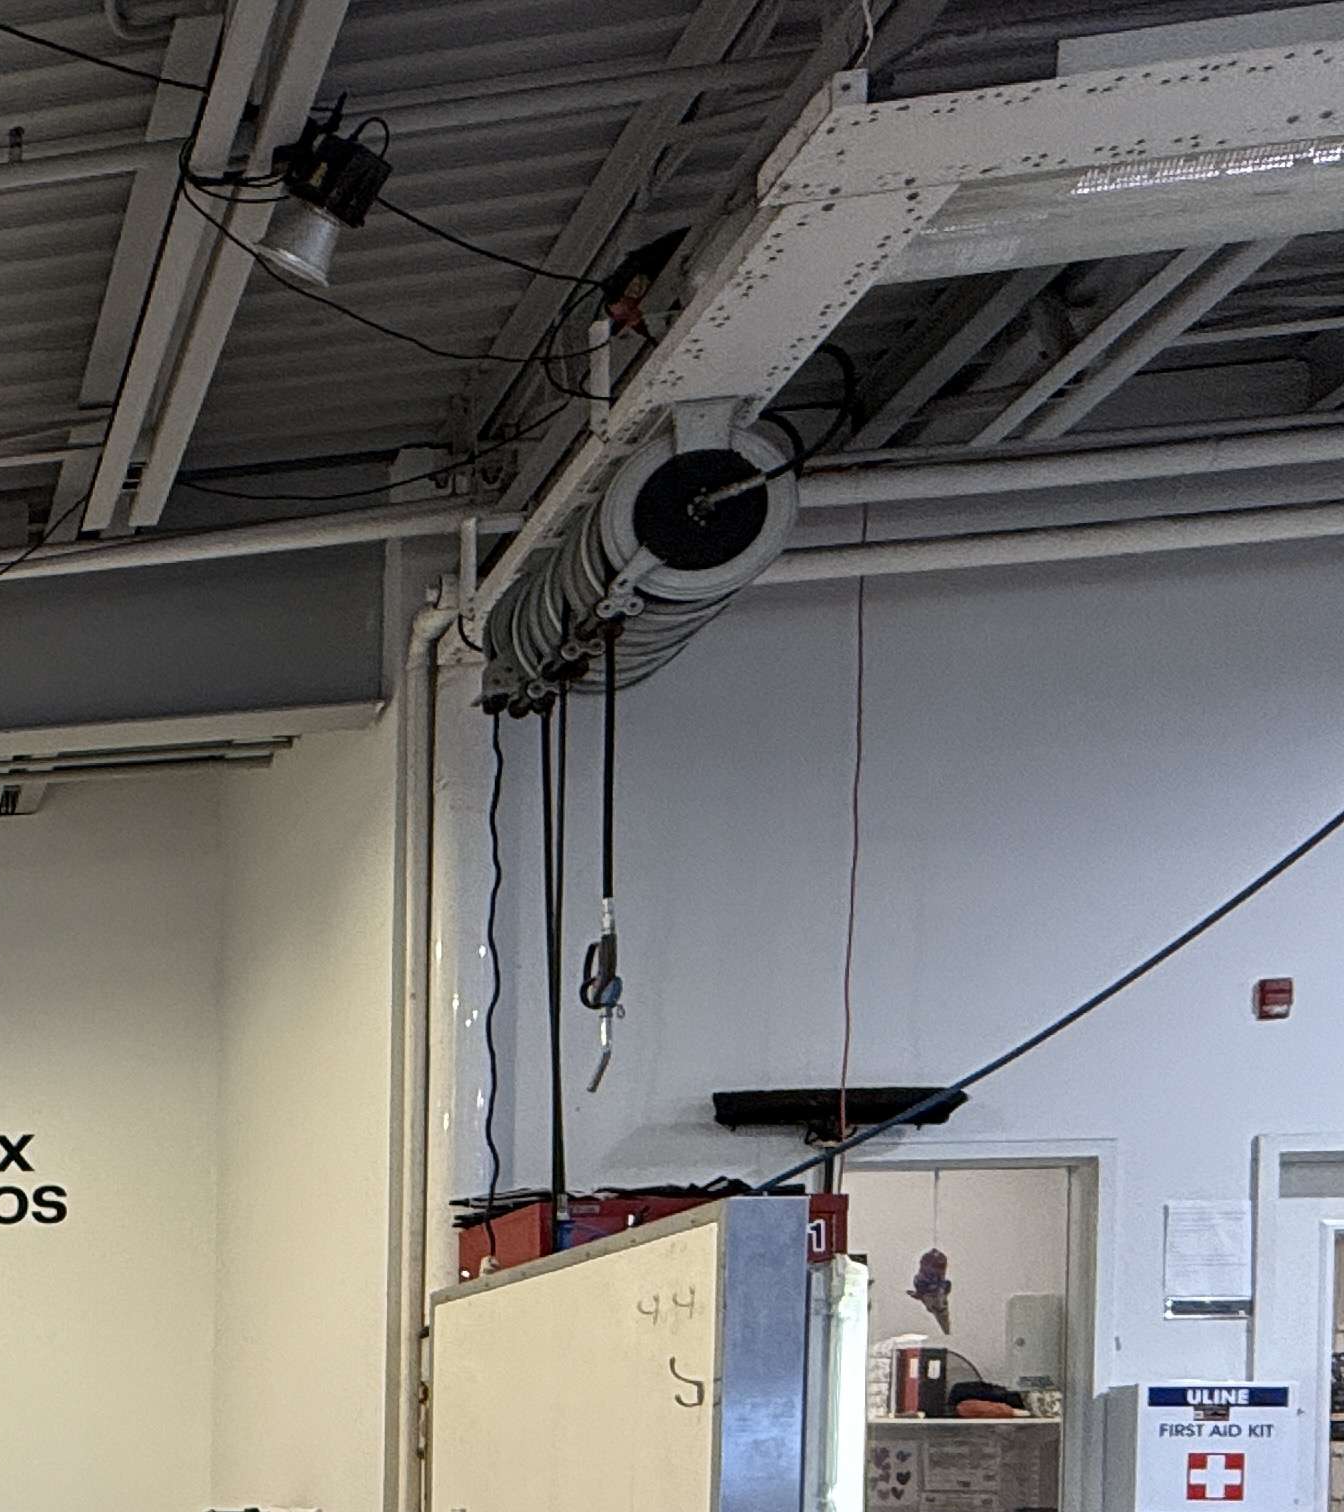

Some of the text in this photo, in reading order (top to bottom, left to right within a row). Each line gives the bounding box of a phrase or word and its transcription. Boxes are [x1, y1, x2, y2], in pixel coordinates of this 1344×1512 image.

[1186, 1388, 1250, 1405] ULINE
[1159, 1423, 1274, 1438] FIRST AID KIT
